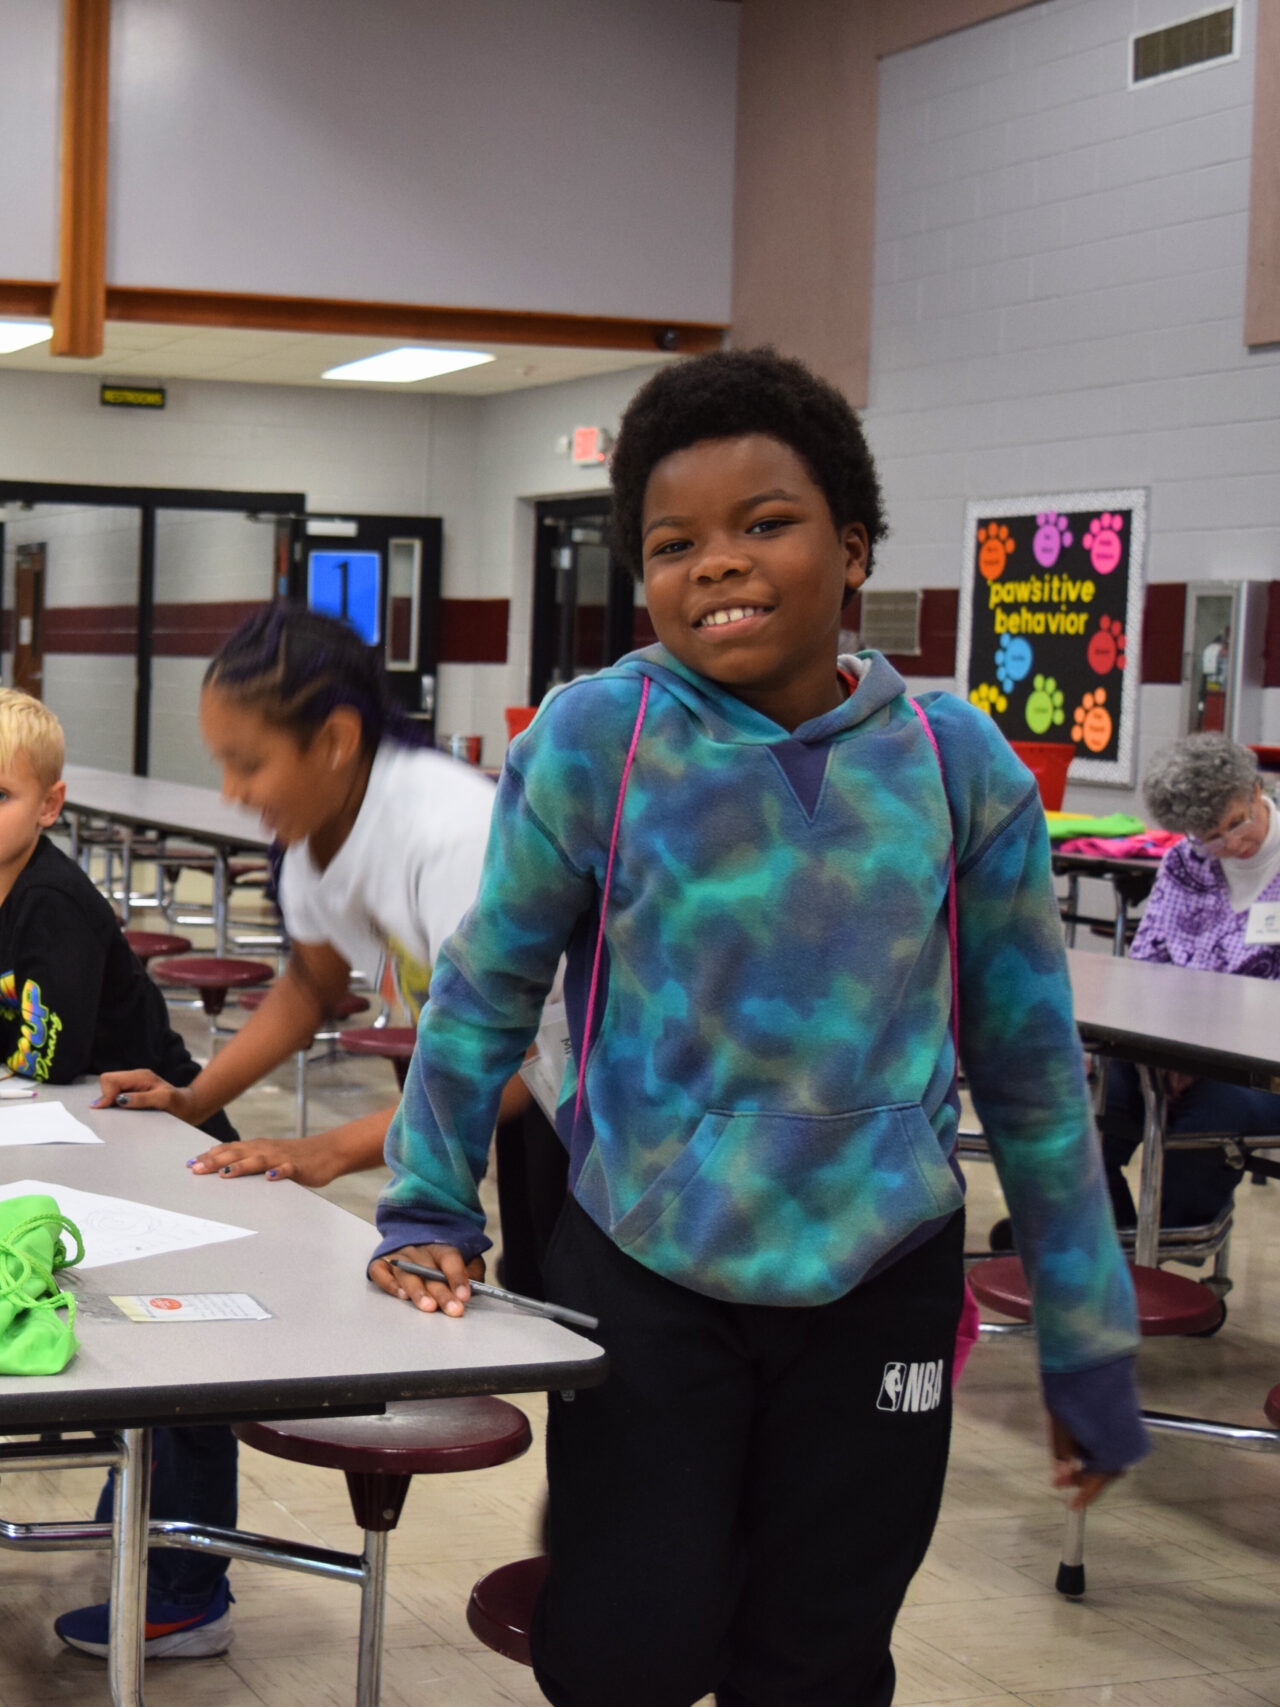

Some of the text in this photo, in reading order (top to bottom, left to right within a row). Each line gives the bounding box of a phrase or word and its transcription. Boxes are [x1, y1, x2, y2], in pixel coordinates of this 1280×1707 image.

[331, 560, 350, 619] 1
[994, 603, 1089, 635] behavior
[901, 1359, 943, 1413] NBA
